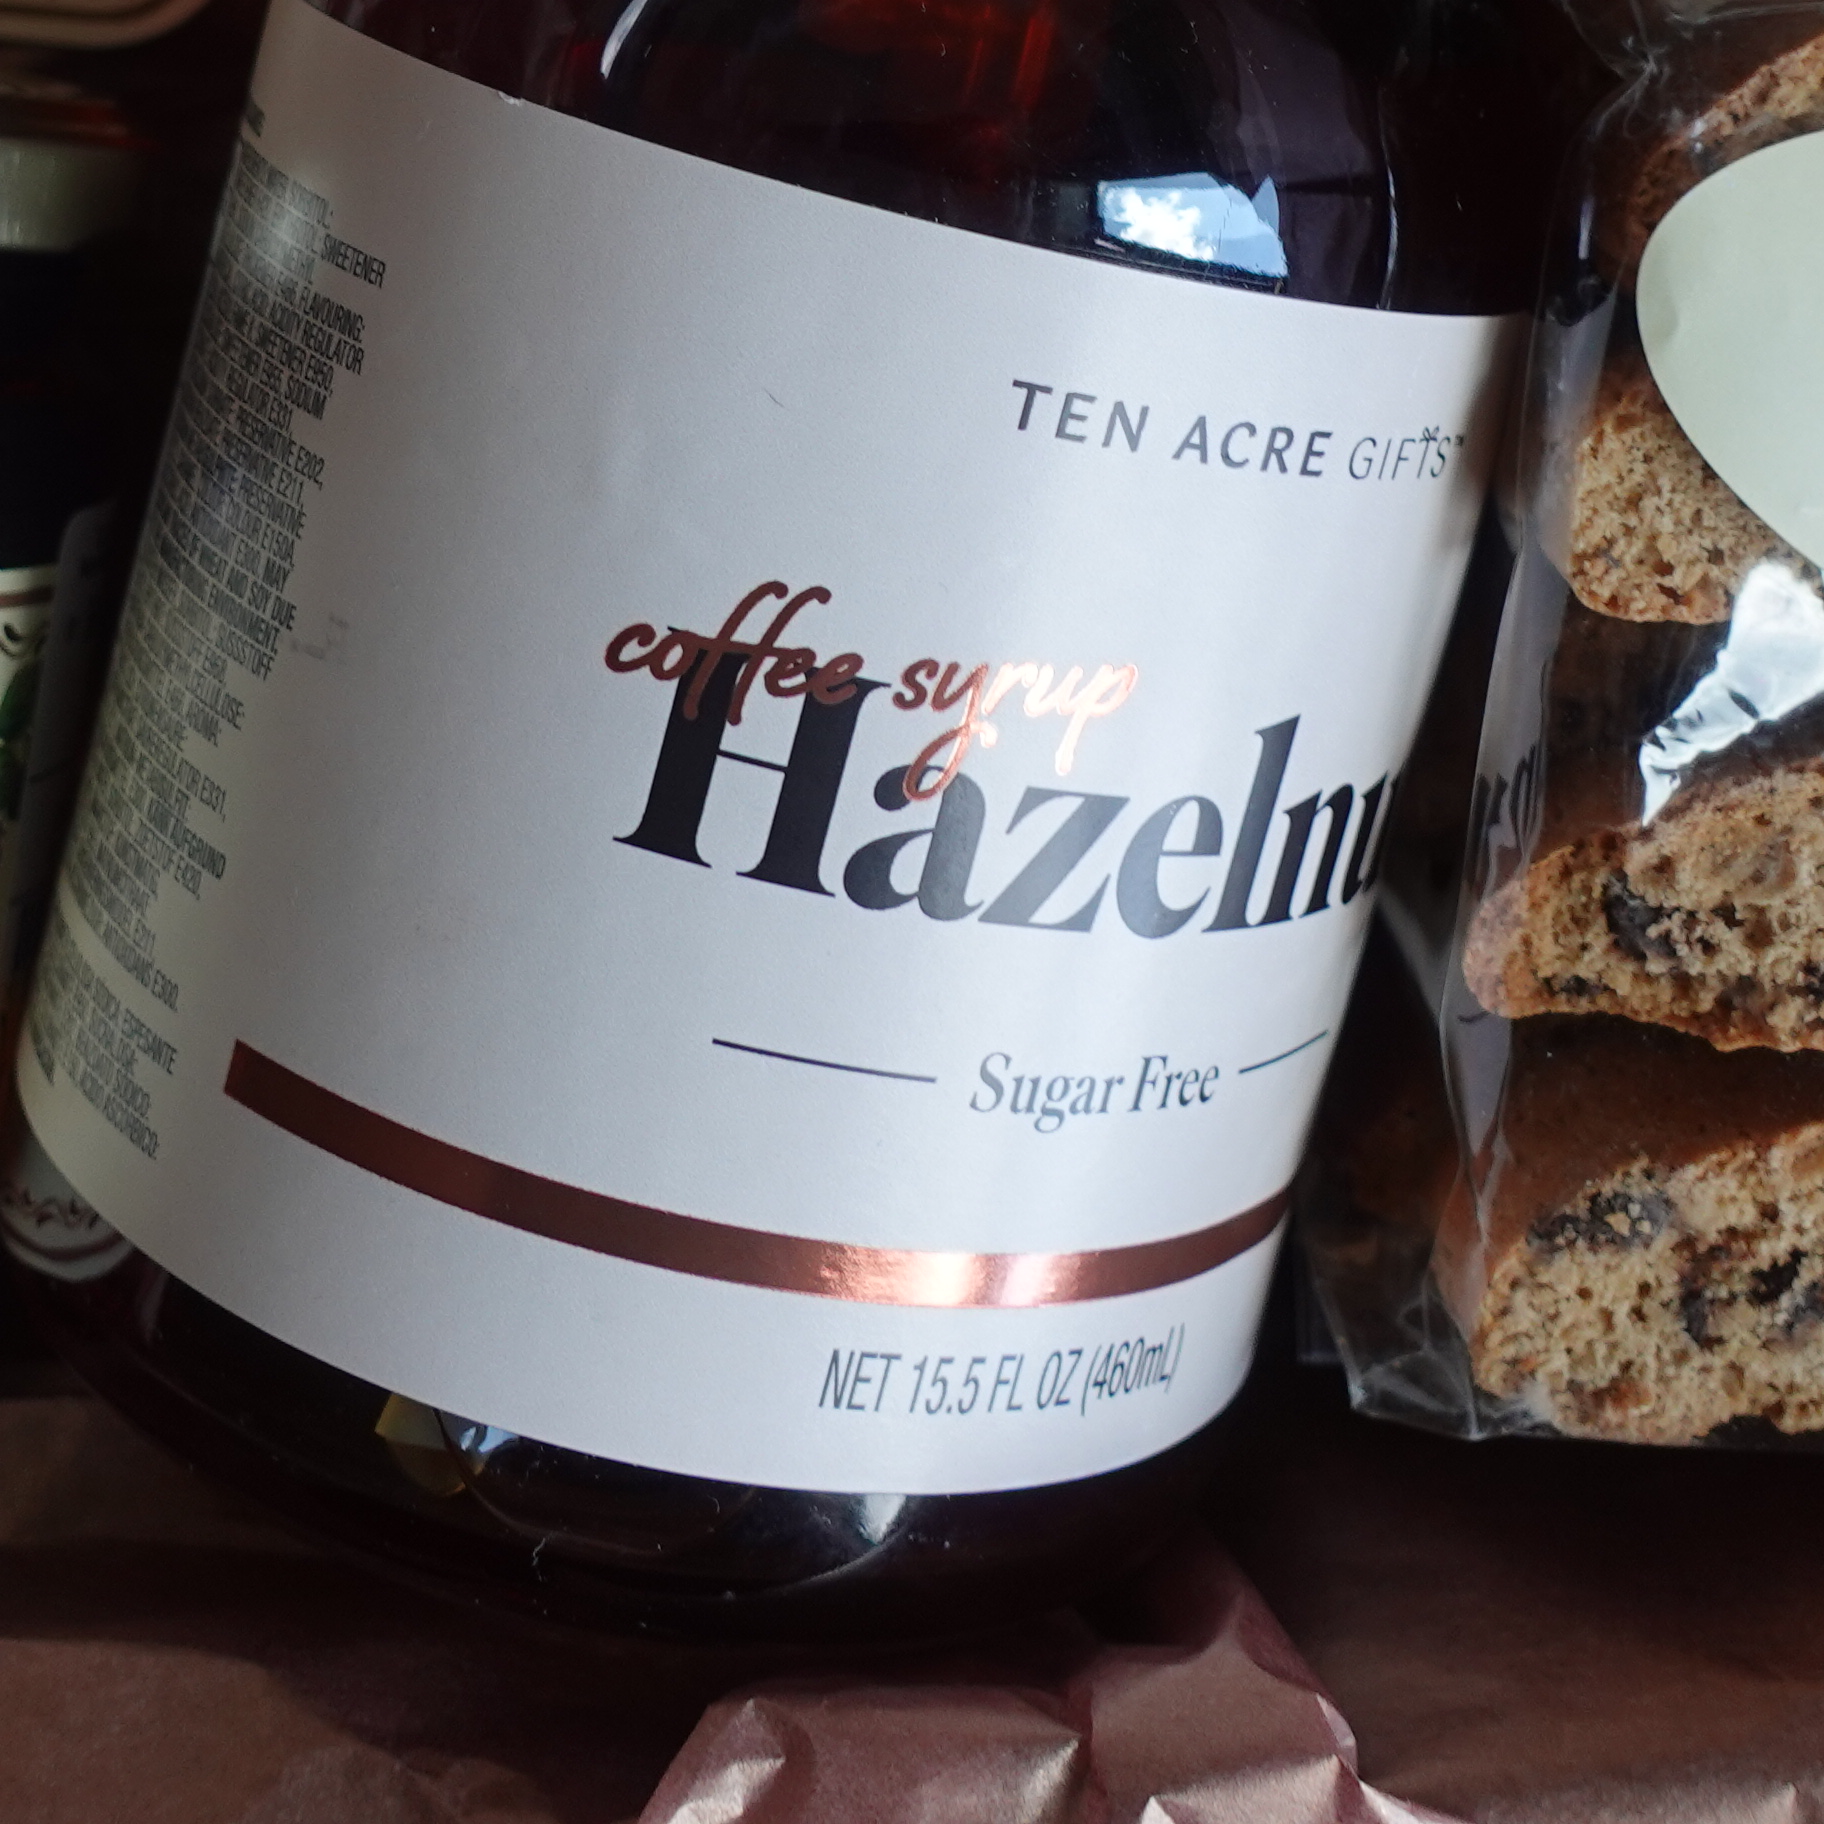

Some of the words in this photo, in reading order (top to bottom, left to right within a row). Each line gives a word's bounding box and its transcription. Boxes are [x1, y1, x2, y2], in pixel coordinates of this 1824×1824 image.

[321, 231, 387, 290] SWEETENER
[1011, 378, 1150, 453] TEN
[1172, 412, 1334, 479] ACRE
[604, 580, 865, 727] coffee
[892, 654, 1140, 803] syrup
[613, 625, 1398, 939] Hazelnu
[969, 1051, 1130, 1134] Sugar
[1130, 1053, 1221, 1114] Free
[817, 1347, 903, 1413] NET
[907, 1354, 981, 1418] 15.5
[987, 1353, 1025, 1413] FL
[1035, 1349, 1082, 1408] OZ
